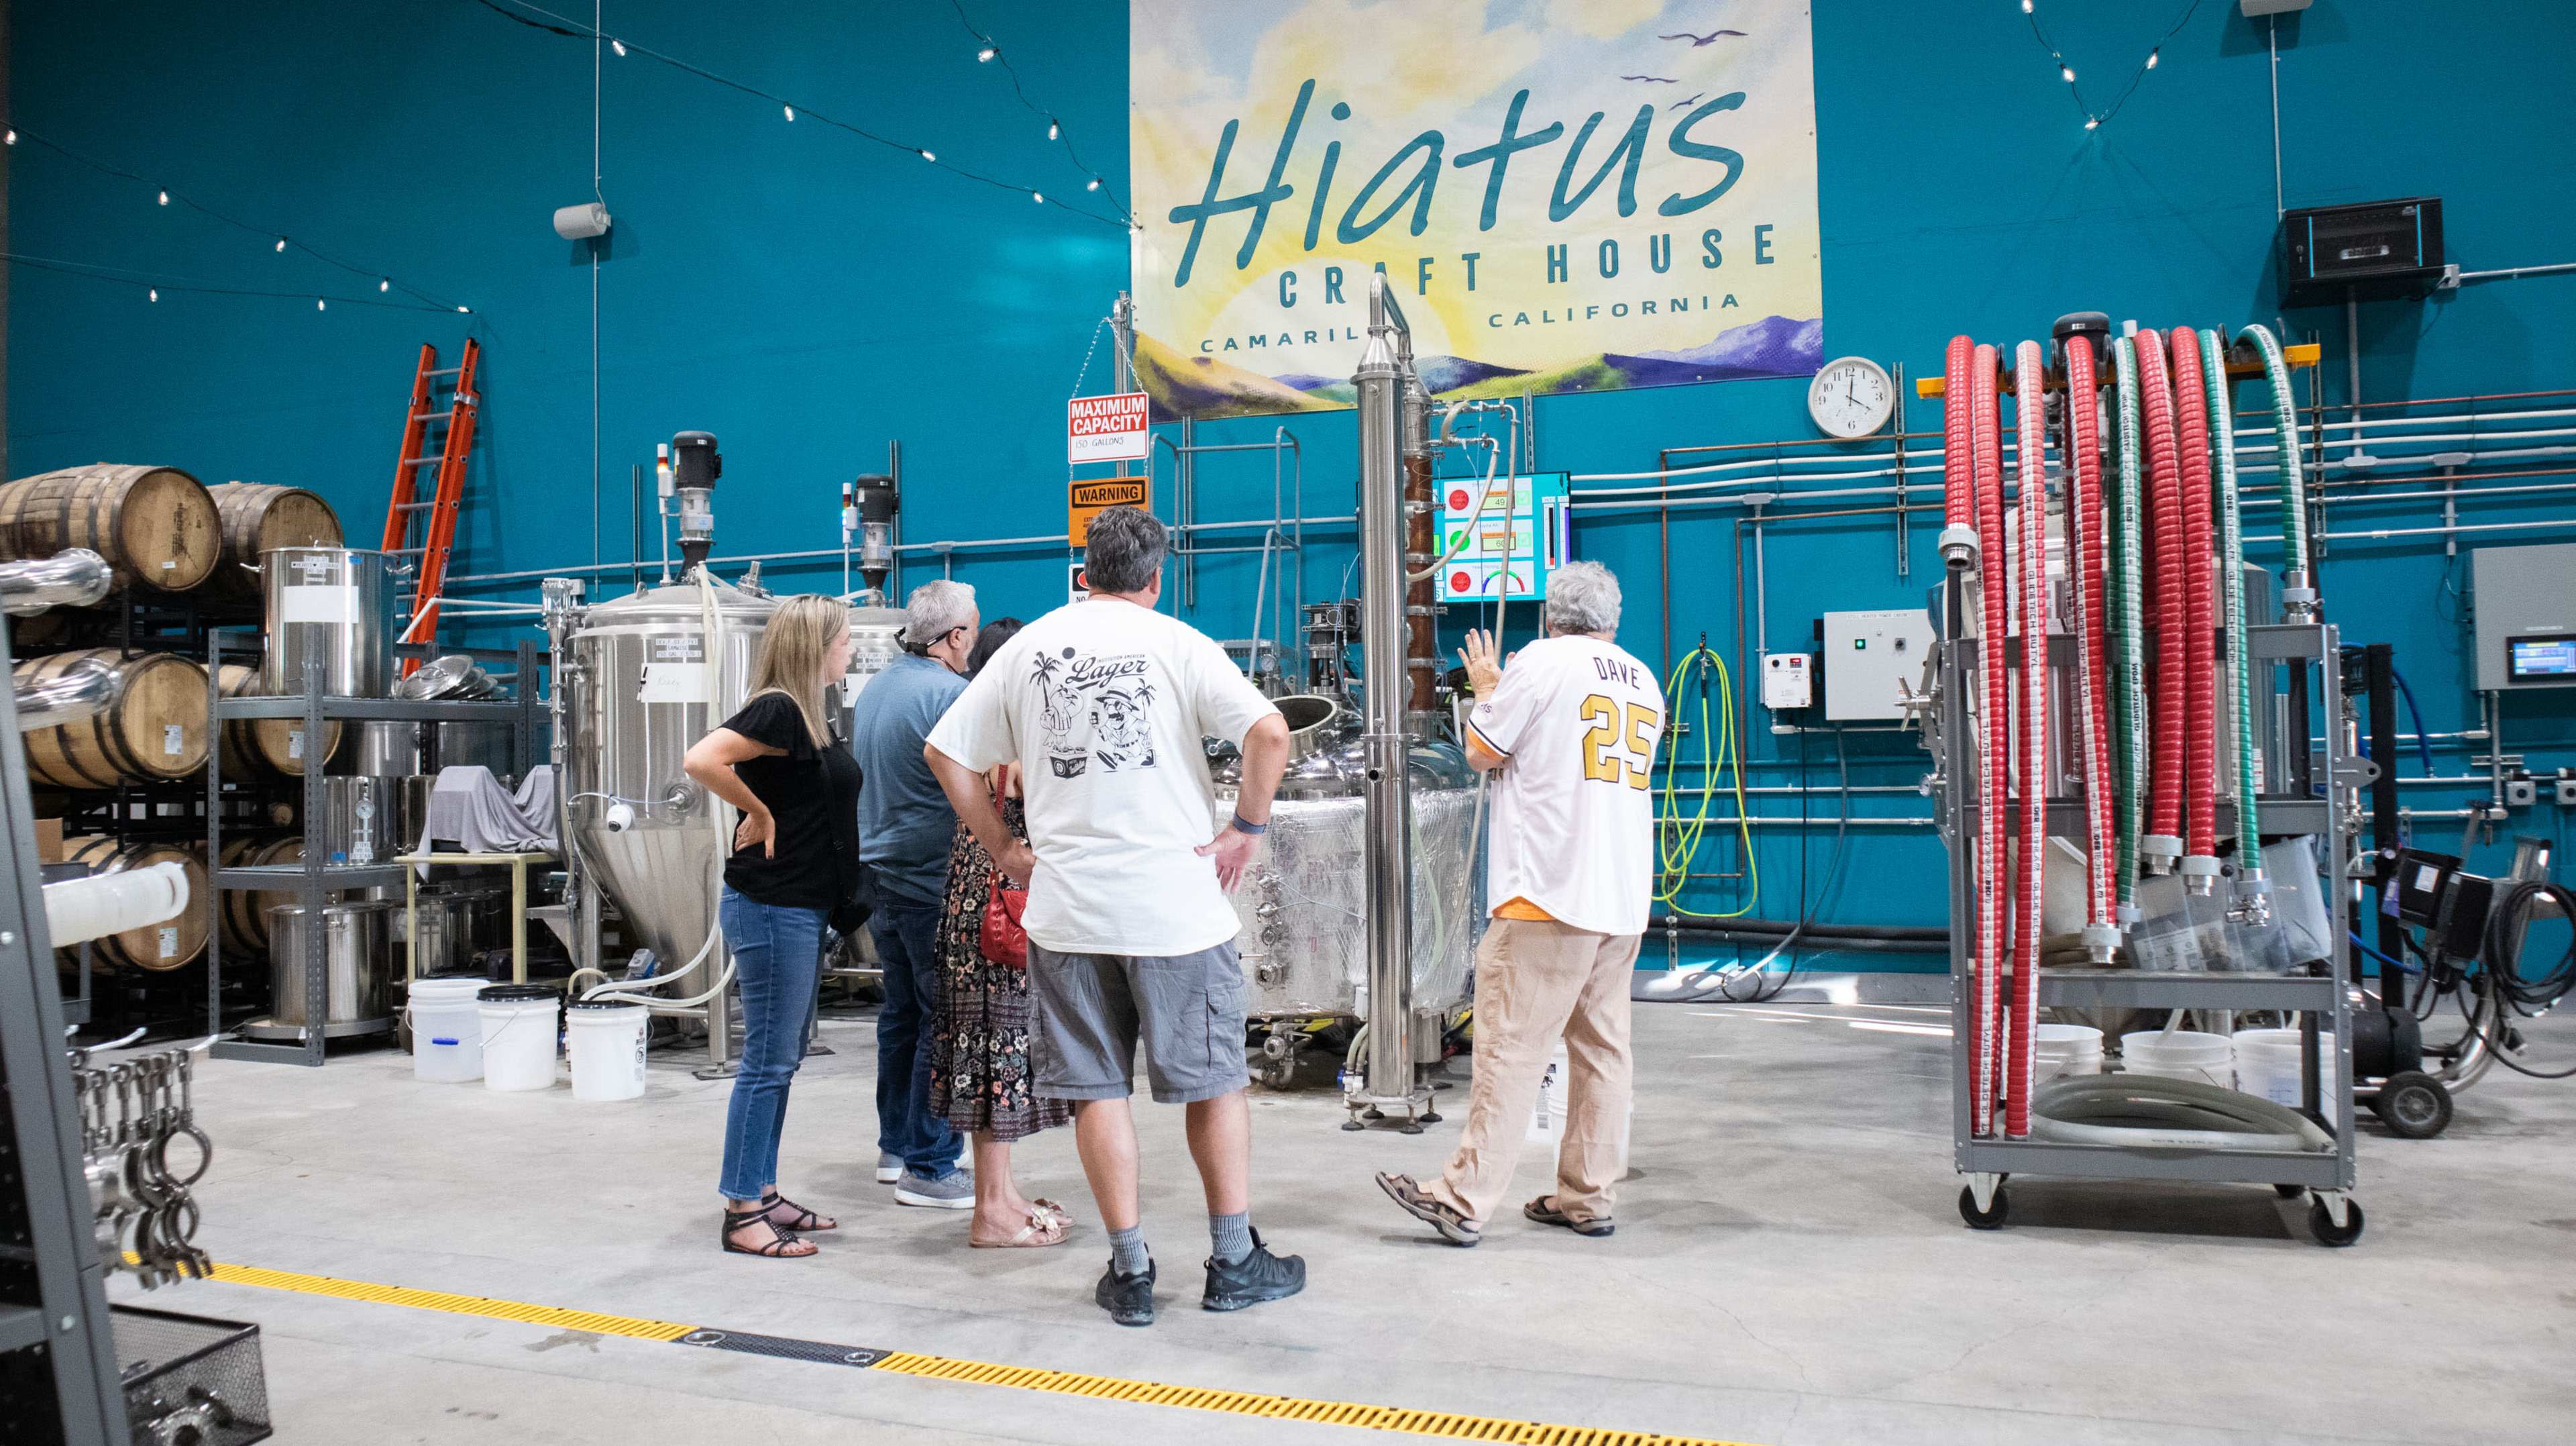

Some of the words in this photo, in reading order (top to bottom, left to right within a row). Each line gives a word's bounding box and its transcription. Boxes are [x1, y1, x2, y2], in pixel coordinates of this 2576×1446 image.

[1169, 78, 1747, 289] Hiatus
[1546, 223, 1775, 285] HOUSE
[1200, 326, 1360, 353] CAMARIL
[1489, 293, 1741, 329] CALIFORNIA
[1845, 368, 1855, 377] 12
[1823, 382, 1833, 393] 10
[1875, 393, 1883, 401] 3
[1071, 397, 1145, 419] MAXIMUM
[1819, 396, 1826, 405] 9
[1073, 414, 1142, 435] CAPACITY
[1847, 419, 1856, 429] 6
[1075, 440, 1088, 449] 150
[1091, 436, 1124, 446] GALLONS
[1079, 486, 1138, 503] WARNING
[2030, 634, 2039, 670] BUTYL
[1065, 656, 1150, 688] Lager
[1593, 657, 1640, 690] DAVE
[1580, 693, 1658, 792] 25
[1982, 721, 1990, 757] BUTYL
